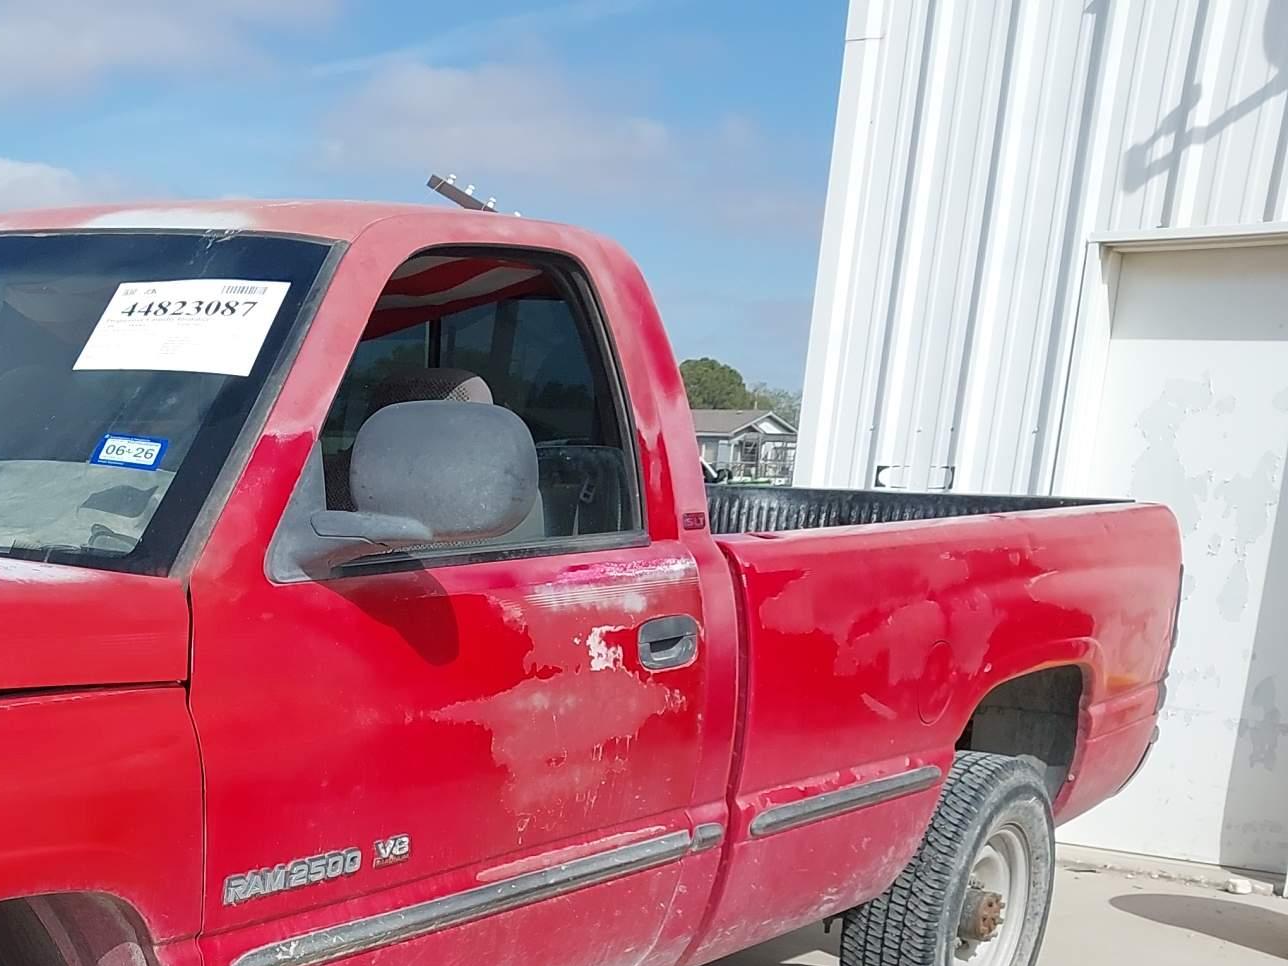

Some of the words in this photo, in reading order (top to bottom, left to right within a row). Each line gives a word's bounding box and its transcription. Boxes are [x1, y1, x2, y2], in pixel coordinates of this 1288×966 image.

[121, 299, 258, 317] 44823087
[686, 516, 705, 527] SLT
[374, 834, 410, 859] V8
